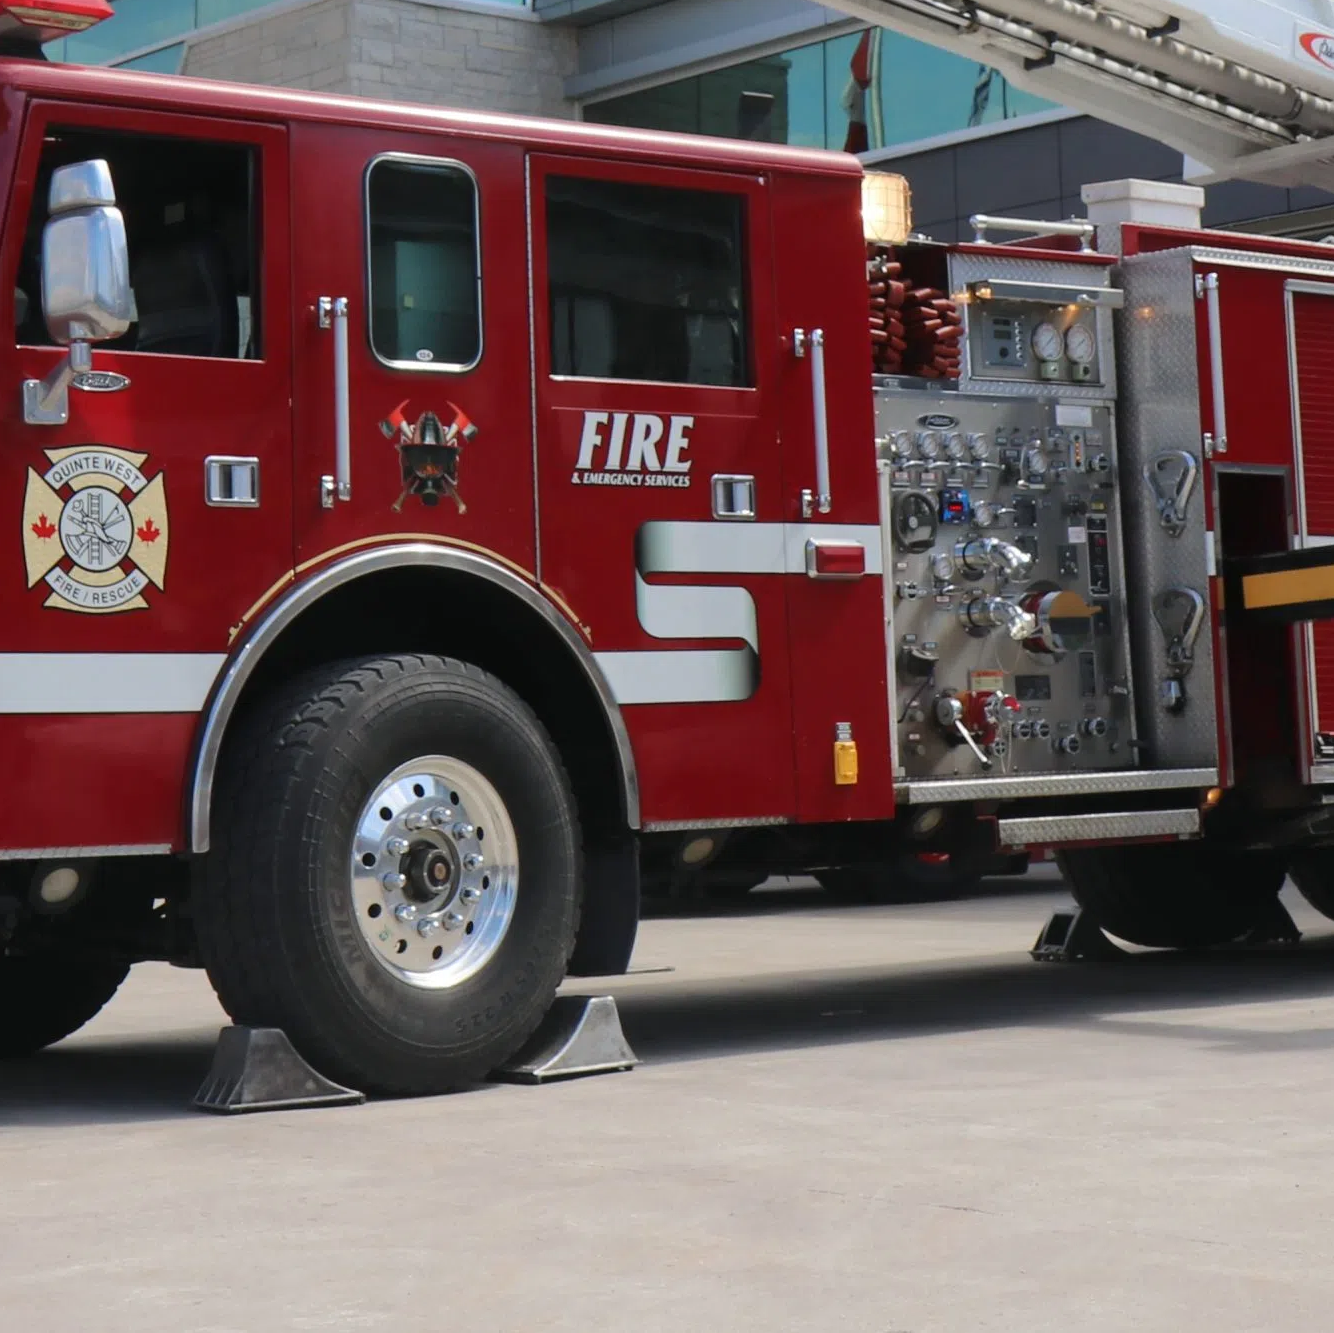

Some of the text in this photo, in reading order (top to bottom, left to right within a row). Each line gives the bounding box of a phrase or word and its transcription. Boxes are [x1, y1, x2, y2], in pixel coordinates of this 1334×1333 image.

[574, 410, 695, 472] FIRE
[52, 456, 141, 485] QUINTE WEST
[571, 471, 690, 487] & EMERGENCY SERVICES
[53, 574, 80, 599] FIRE
[92, 576, 141, 605] RESCUE
